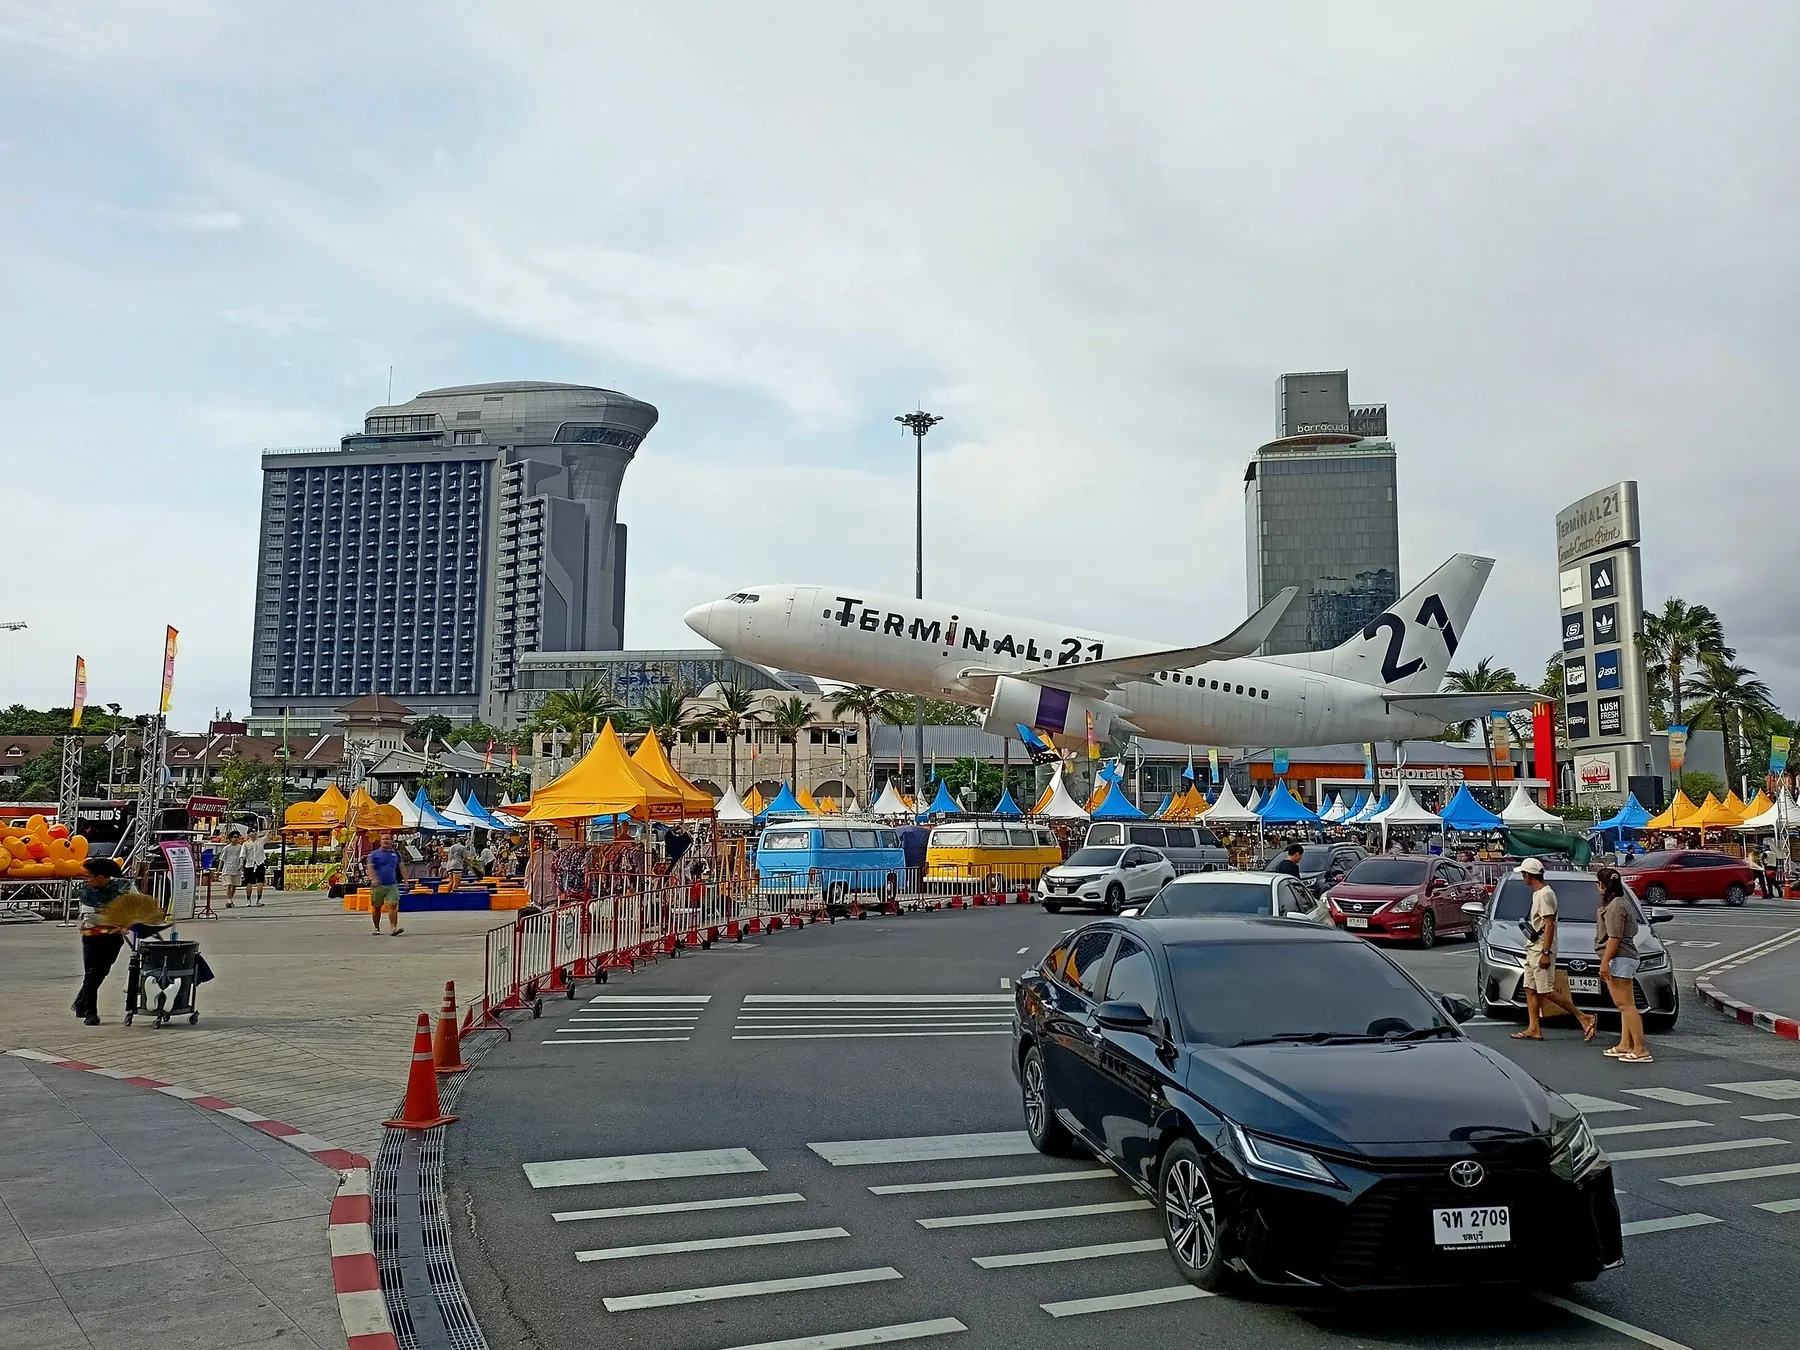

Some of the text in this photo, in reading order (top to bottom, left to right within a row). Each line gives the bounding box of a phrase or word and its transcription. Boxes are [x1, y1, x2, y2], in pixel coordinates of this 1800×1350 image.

[1297, 423, 1349, 433] barracuda
[1603, 492, 1619, 517] 21
[1363, 593, 1459, 685] 21
[1058, 637, 1105, 665] 21
[618, 674, 670, 685] SPACE
[1600, 702, 1618, 711] LUSH
[1601, 711, 1619, 719] FRESH
[1378, 767, 1465, 779] cDonald's
[1579, 979, 1598, 987] 1482
[1470, 1209, 1508, 1227] 2709
[1462, 1230, 1483, 1242] ชลบุรี
